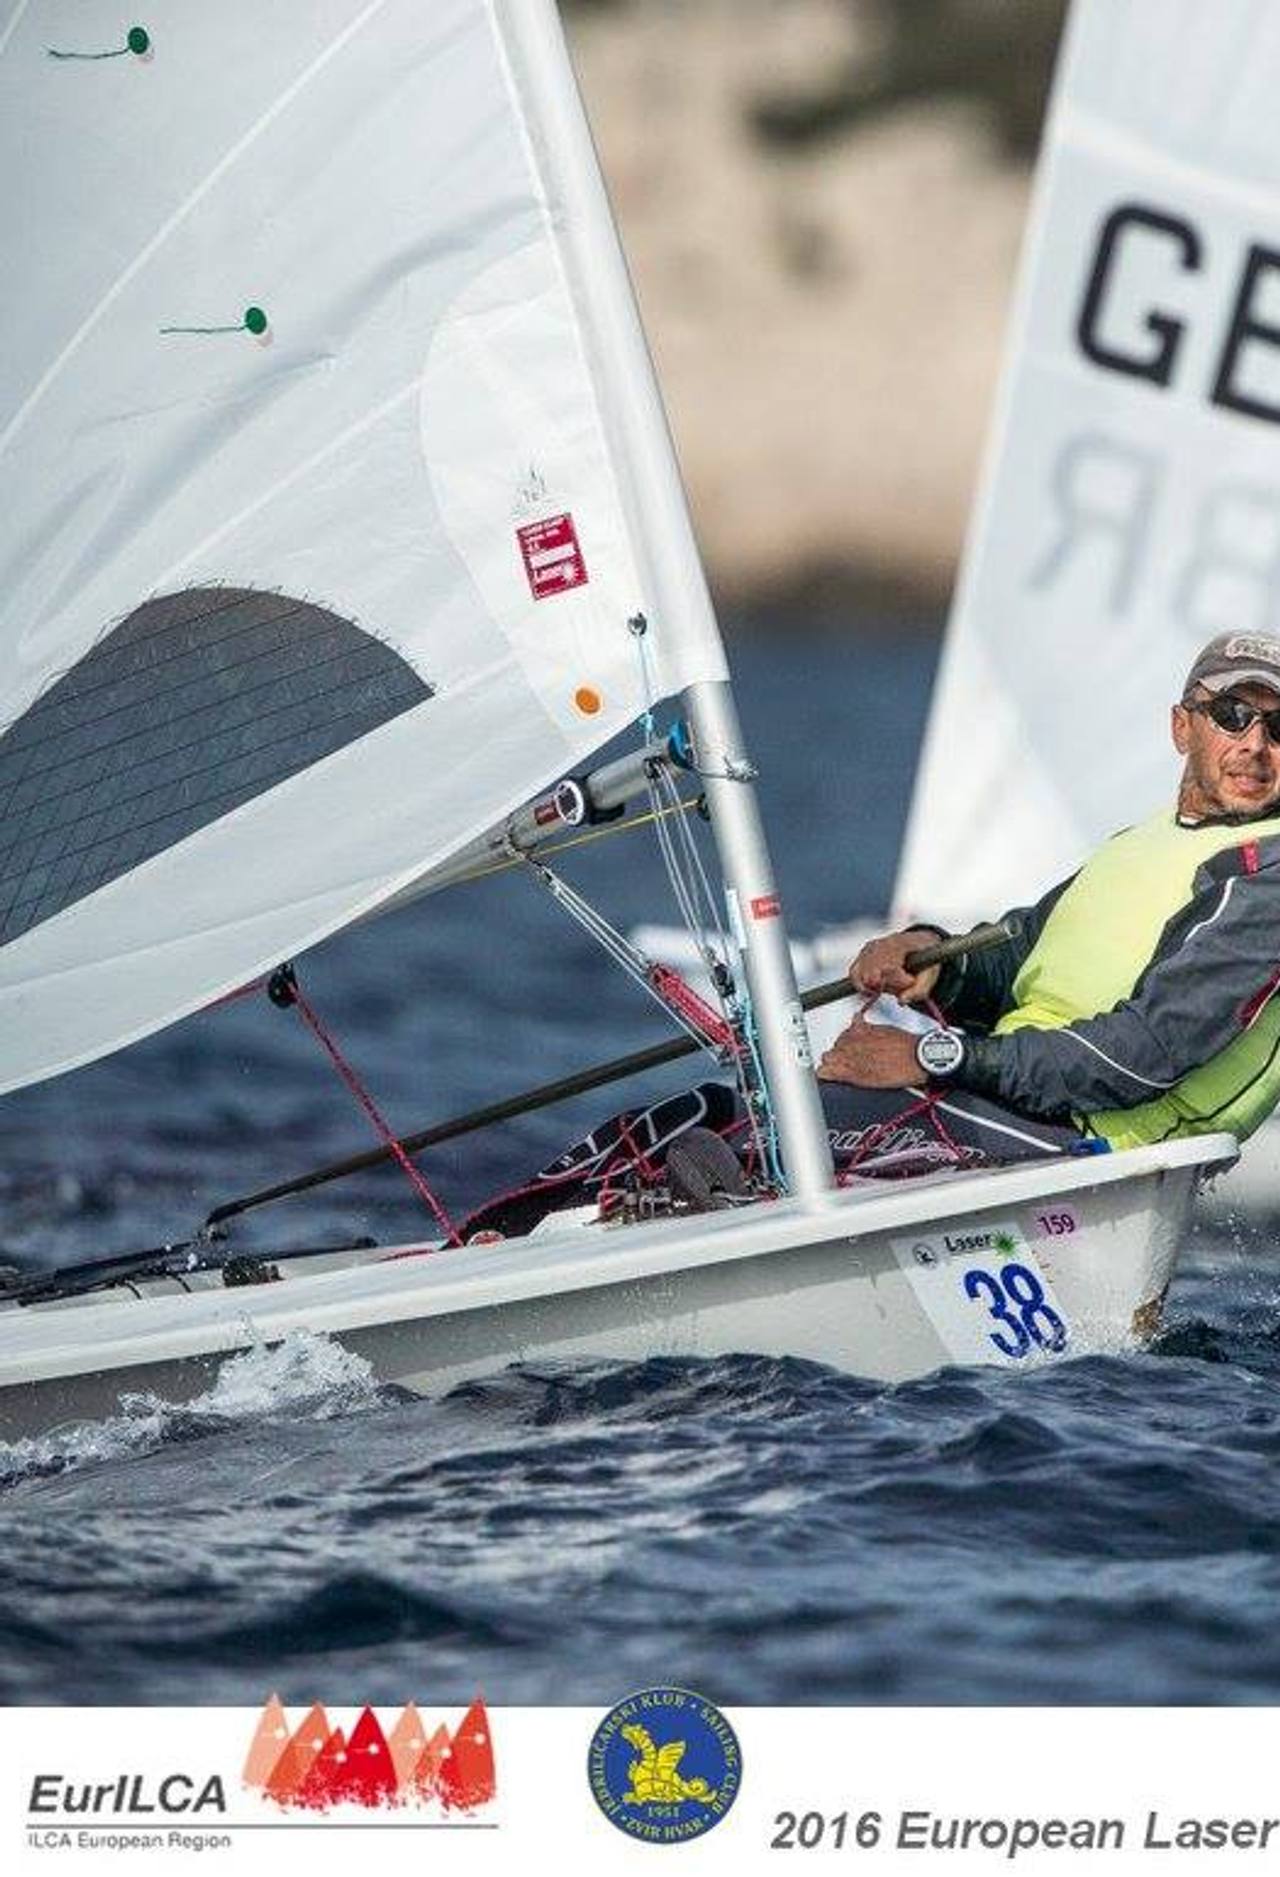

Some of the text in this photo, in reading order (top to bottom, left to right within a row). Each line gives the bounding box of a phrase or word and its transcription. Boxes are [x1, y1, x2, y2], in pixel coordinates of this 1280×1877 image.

[1040, 1214, 1077, 1235] 159
[944, 1233, 993, 1252] Laser
[963, 1263, 1067, 1359] 38
